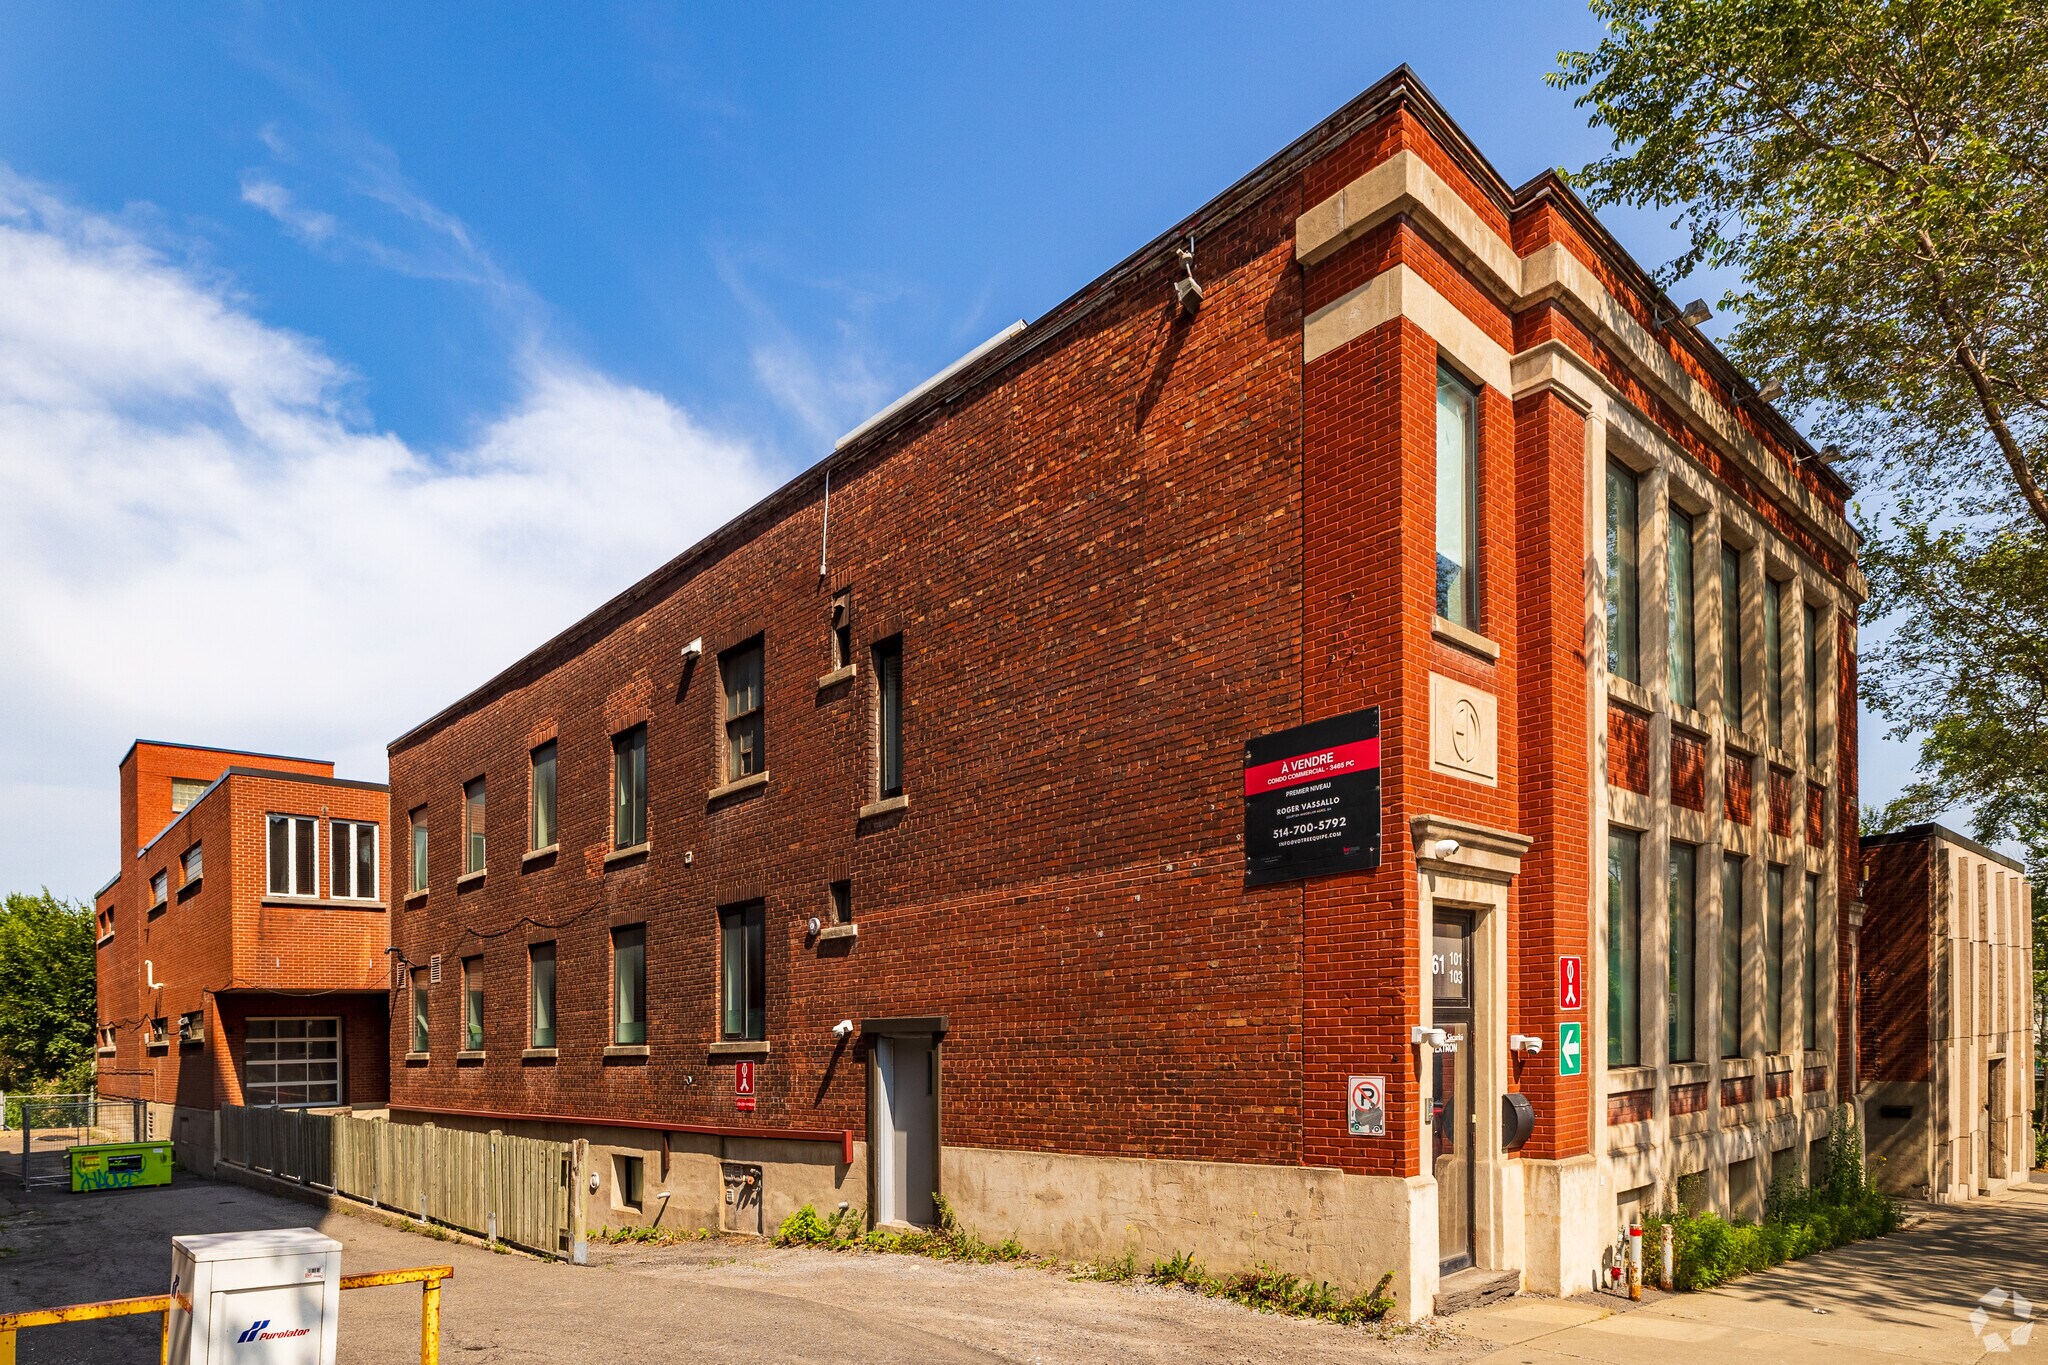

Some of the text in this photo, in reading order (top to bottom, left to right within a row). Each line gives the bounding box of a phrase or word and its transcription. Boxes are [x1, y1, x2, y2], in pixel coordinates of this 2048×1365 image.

[1281, 752, 1334, 774] À VENDRE
[1267, 775, 1287, 785] CONDO
[1287, 767, 1325, 780] COMMERCIAL
[1345, 760, 1355, 768] PC
[1285, 782, 1332, 798] PREMIER NIVEAU
[1276, 797, 1340, 816] ROGER VASSALLO
[1272, 817, 1347, 839] 514-700-5792
[1449, 951, 1462, 966] 101
[1449, 969, 1463, 984] 103
[258, 1328, 310, 1341] Purolator
